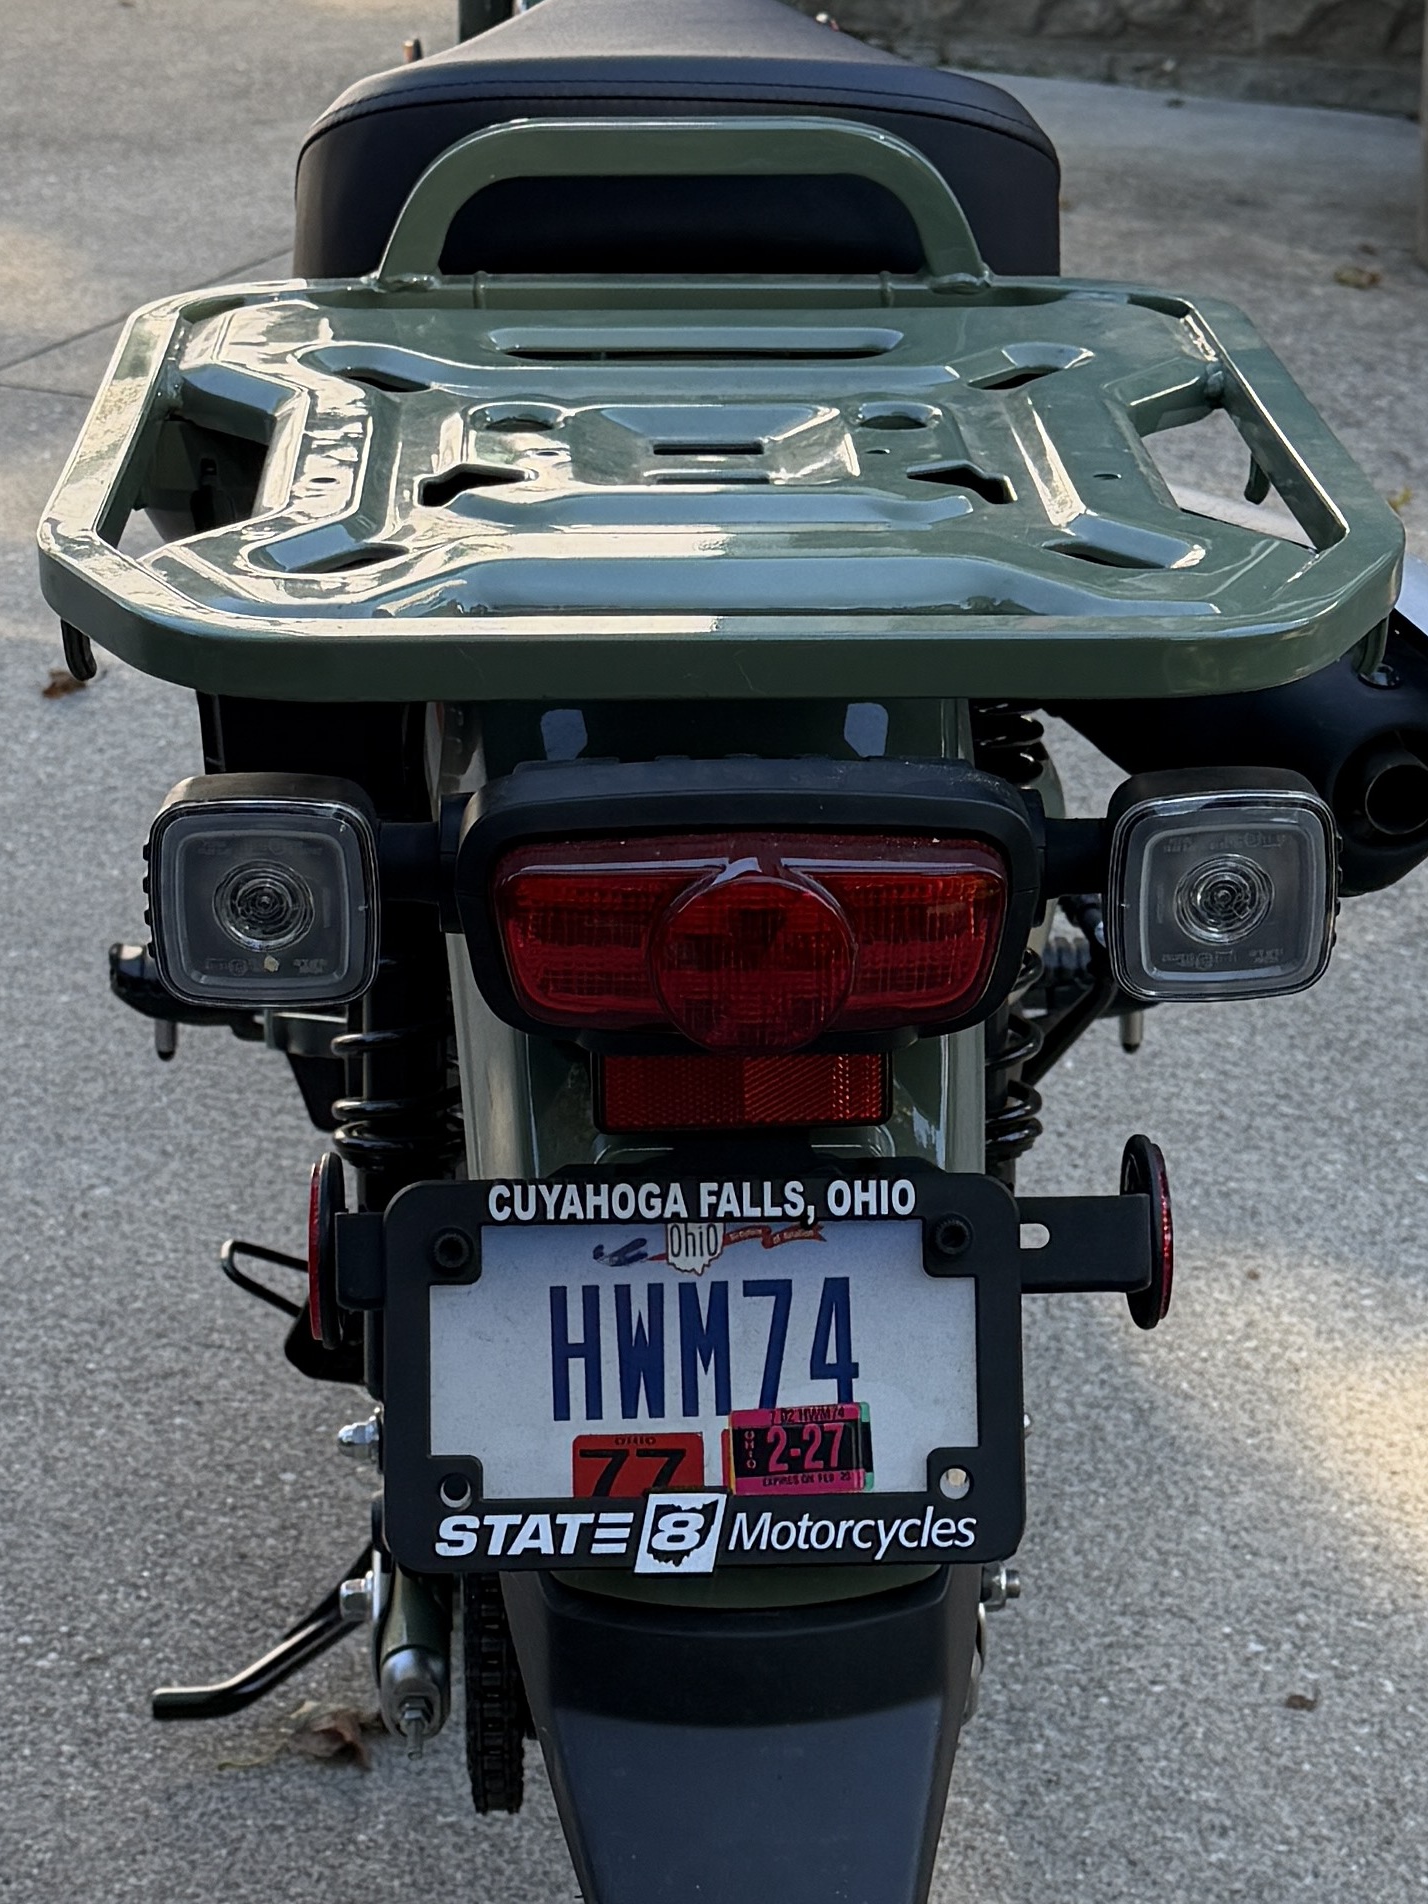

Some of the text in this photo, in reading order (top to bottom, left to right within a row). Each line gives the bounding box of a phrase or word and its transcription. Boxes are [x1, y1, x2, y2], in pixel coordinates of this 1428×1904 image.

[488, 1179, 916, 1226] CUYAHOGA FALLS, OHIO
[549, 1276, 860, 1421] HWM74
[579, 1448, 687, 1497] 77
[766, 1422, 845, 1473] 2-27
[435, 1506, 977, 1560] STATE 8 Motorcycles
